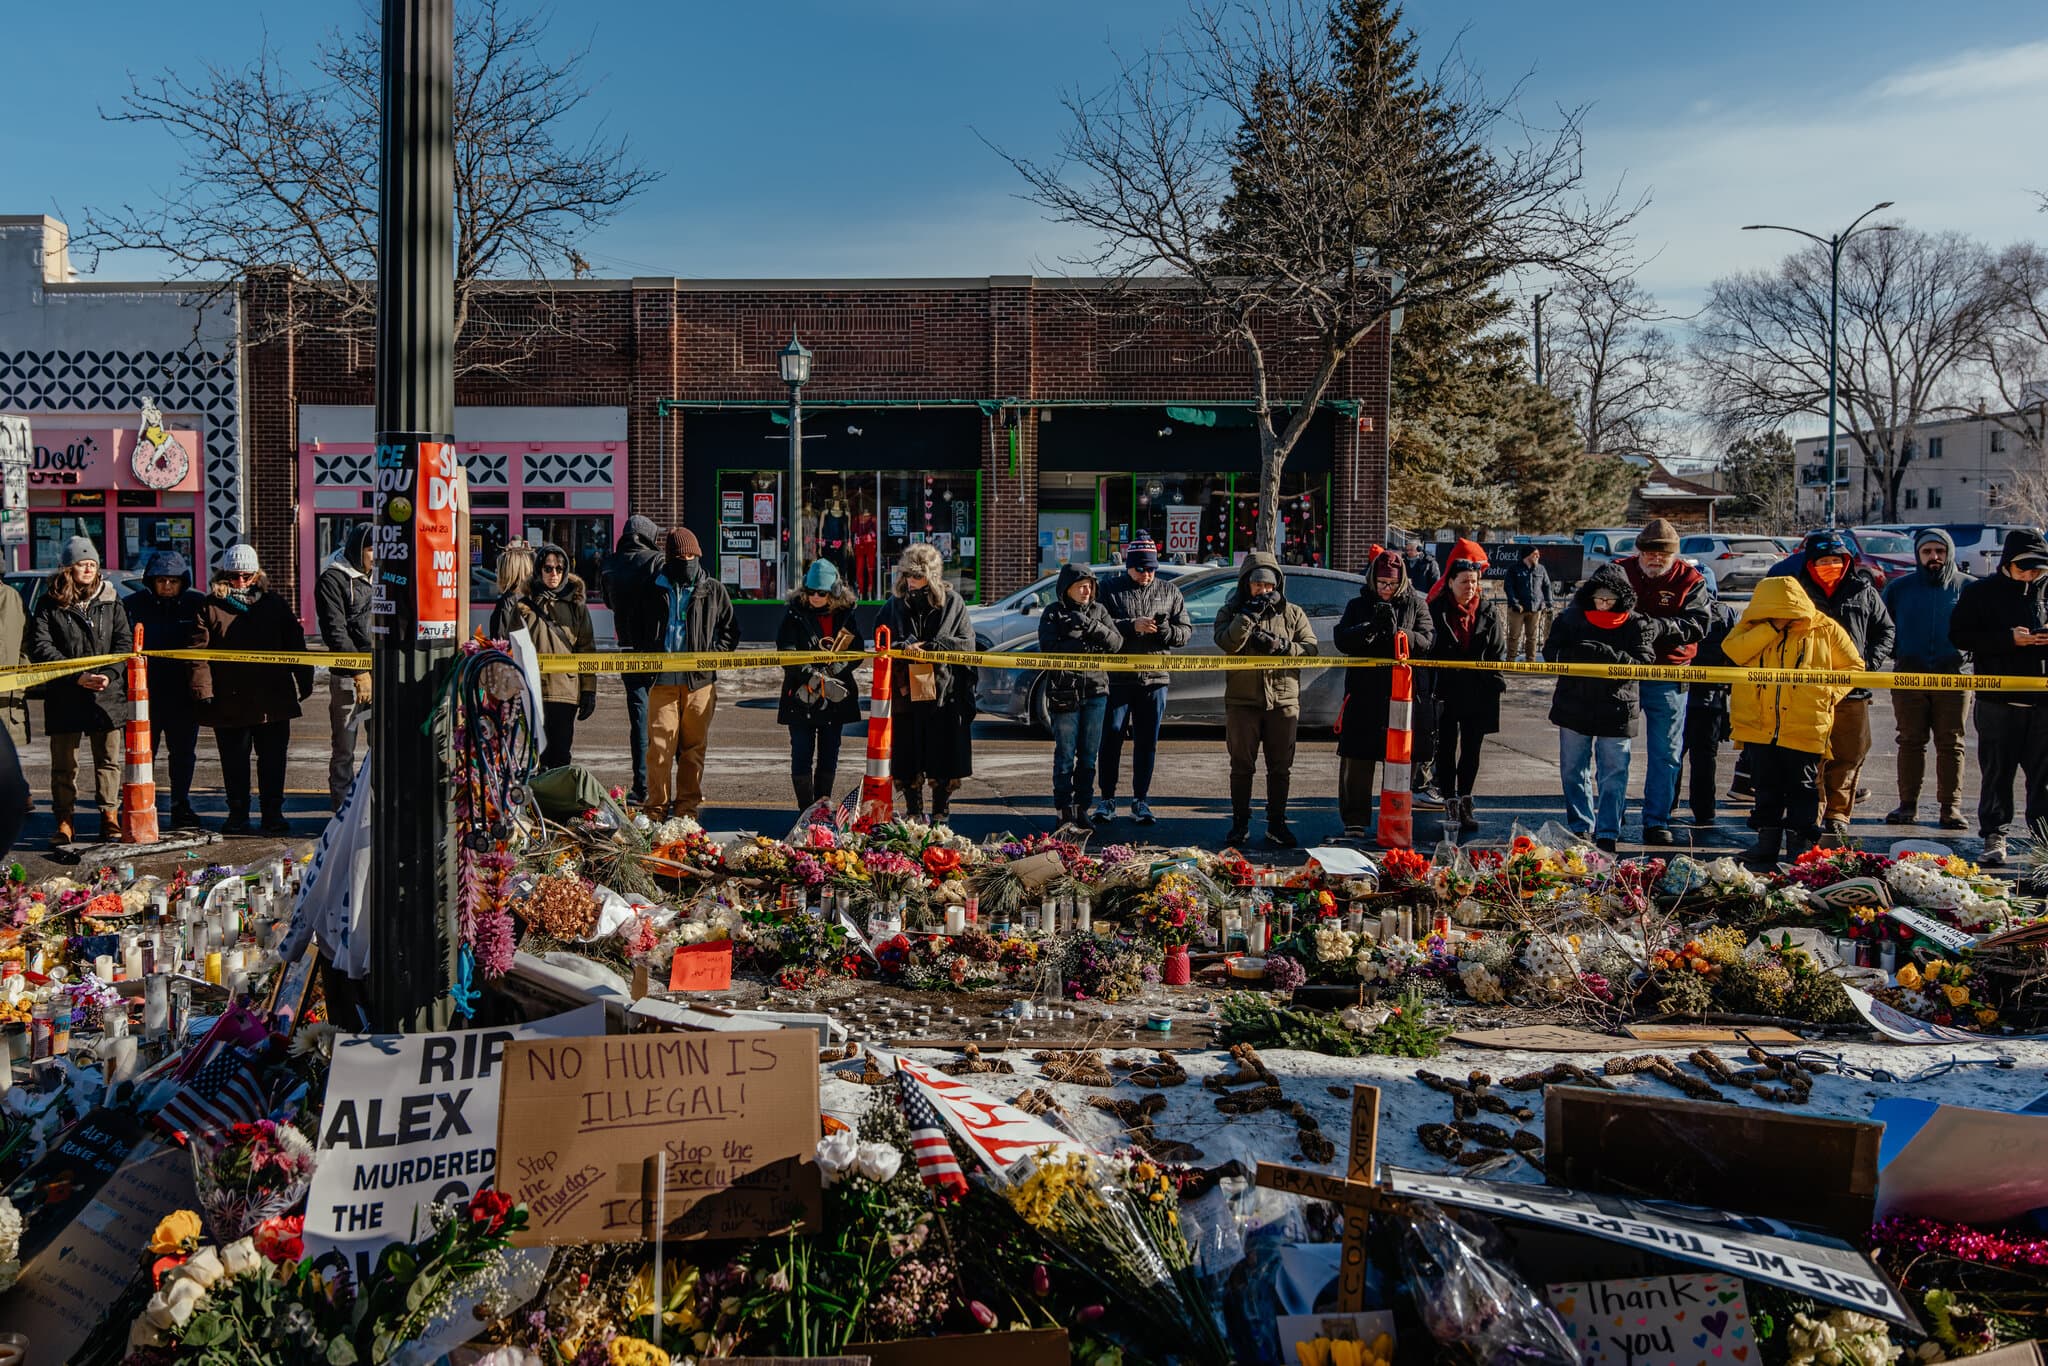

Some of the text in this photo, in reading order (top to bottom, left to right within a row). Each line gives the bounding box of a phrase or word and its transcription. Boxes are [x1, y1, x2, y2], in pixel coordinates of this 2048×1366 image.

[33, 444, 88, 470] Doll
[724, 501, 741, 509] FREE
[382, 525, 402, 542] OF
[1170, 521, 1197, 535] ICE
[1170, 536, 1198, 549] OUT!
[433, 551, 453, 570] NO
[437, 571, 452, 587] NO
[423, 627, 441, 636] ATU
[578, 660, 662, 671] POLICE LINE DO NOT CROSS
[697, 658, 780, 668] POLICE LINE DO NOT CROSS
[1016, 658, 1037, 666] CROSS
[1039, 659, 1049, 667] NOT
[1052, 660, 1062, 668] DO
[1064, 660, 1076, 668] LINE
[1608, 666, 1706, 680] POLICE LINE DO NOT CROSS
[1748, 672, 1851, 684] POLICE LINE DO NOT CROSS
[1895, 675, 2002, 688] POLICE LINE DO NOT CROSS
[420, 1031, 512, 1085] RIP
[528, 1038, 777, 1081] NO HUMN IS
[581, 1083, 745, 1125] ILLEGAL!
[320, 1087, 474, 1150] ALEX
[1354, 1094, 1370, 1178] ALEX
[665, 1140, 753, 1163] Stop the
[353, 1148, 497, 1191] MURDERED
[517, 1150, 558, 1182] Stop
[1272, 1168, 1344, 1197] BRAVE
[332, 1201, 384, 1232] THE
[1552, 1208, 1714, 1258] THERE
[1721, 1242, 1794, 1277] WE
[1588, 1277, 1700, 1314] Thank
[1798, 1265, 1888, 1309] ARE
[1610, 1325, 1675, 1366] you
